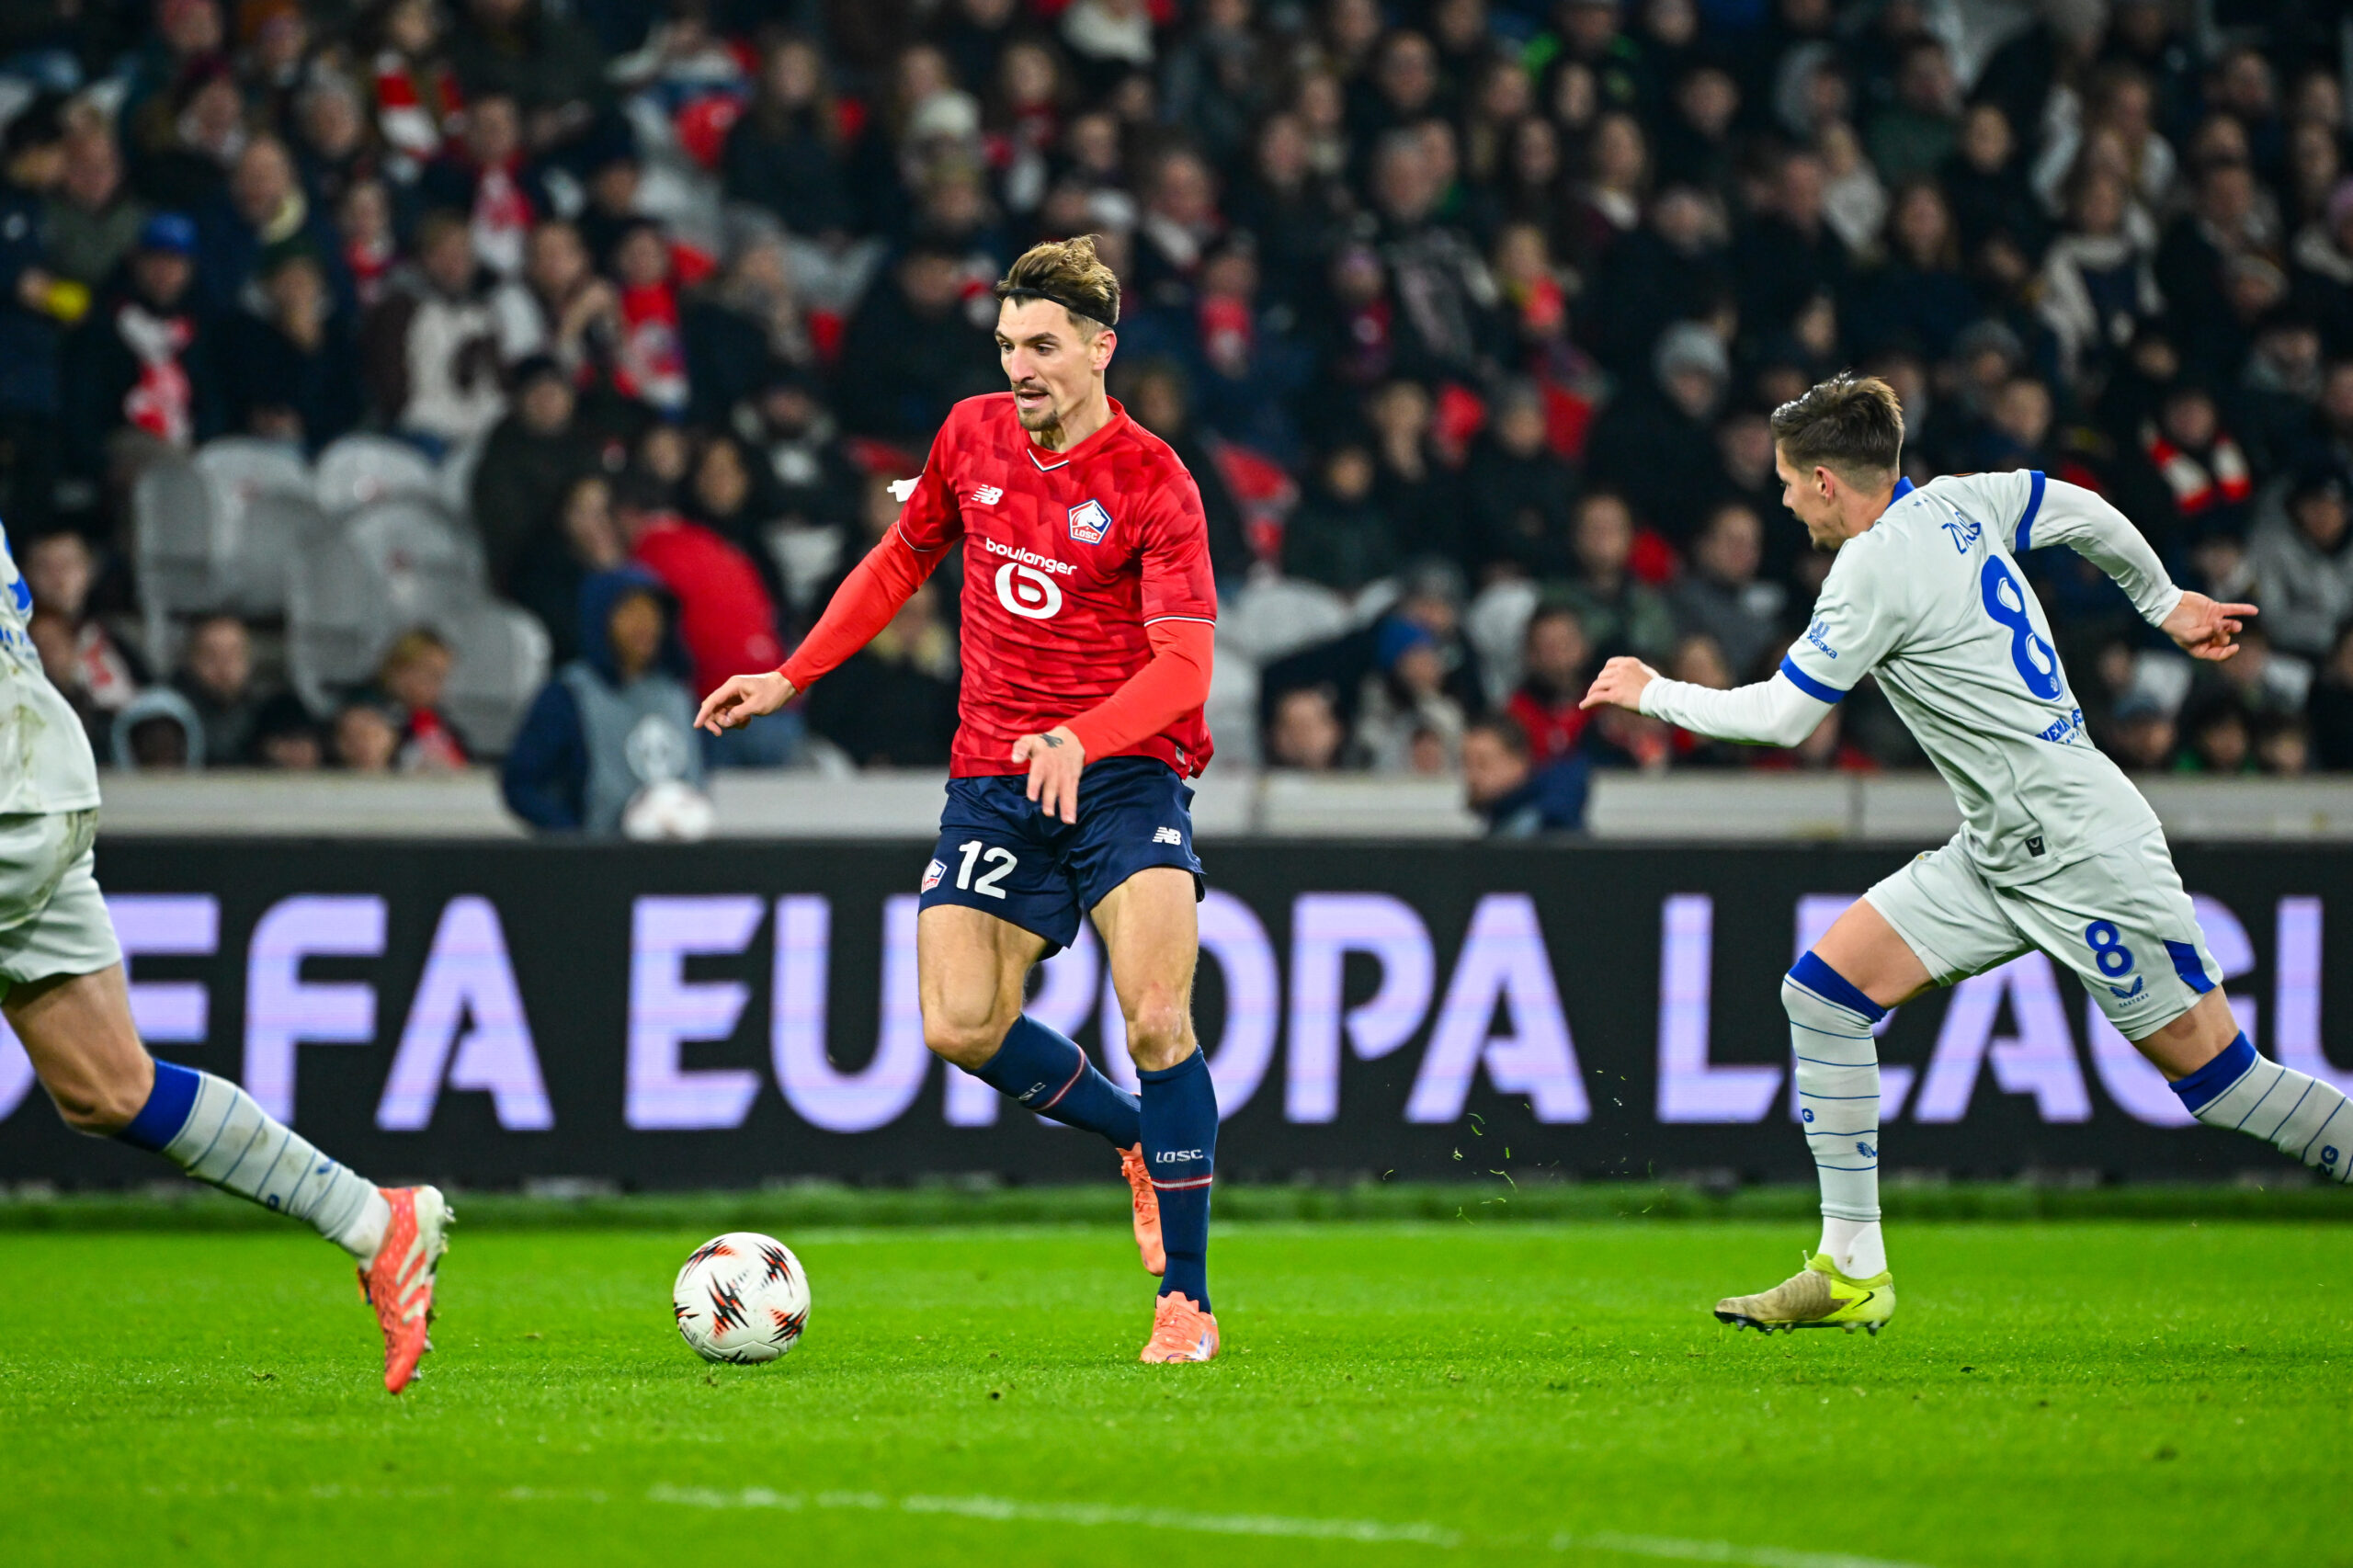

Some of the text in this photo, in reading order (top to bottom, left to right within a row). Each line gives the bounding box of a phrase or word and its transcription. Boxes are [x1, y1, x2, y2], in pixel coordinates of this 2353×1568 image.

[985, 537, 1078, 576] boulanger
[1074, 528, 1098, 540] LOSC
[1981, 554, 2064, 702] 8
[956, 840, 1018, 900] 12
[2085, 919, 2135, 979] 8
[0, 894, 554, 1129] FA
[1155, 1148, 1204, 1164] LOSC
